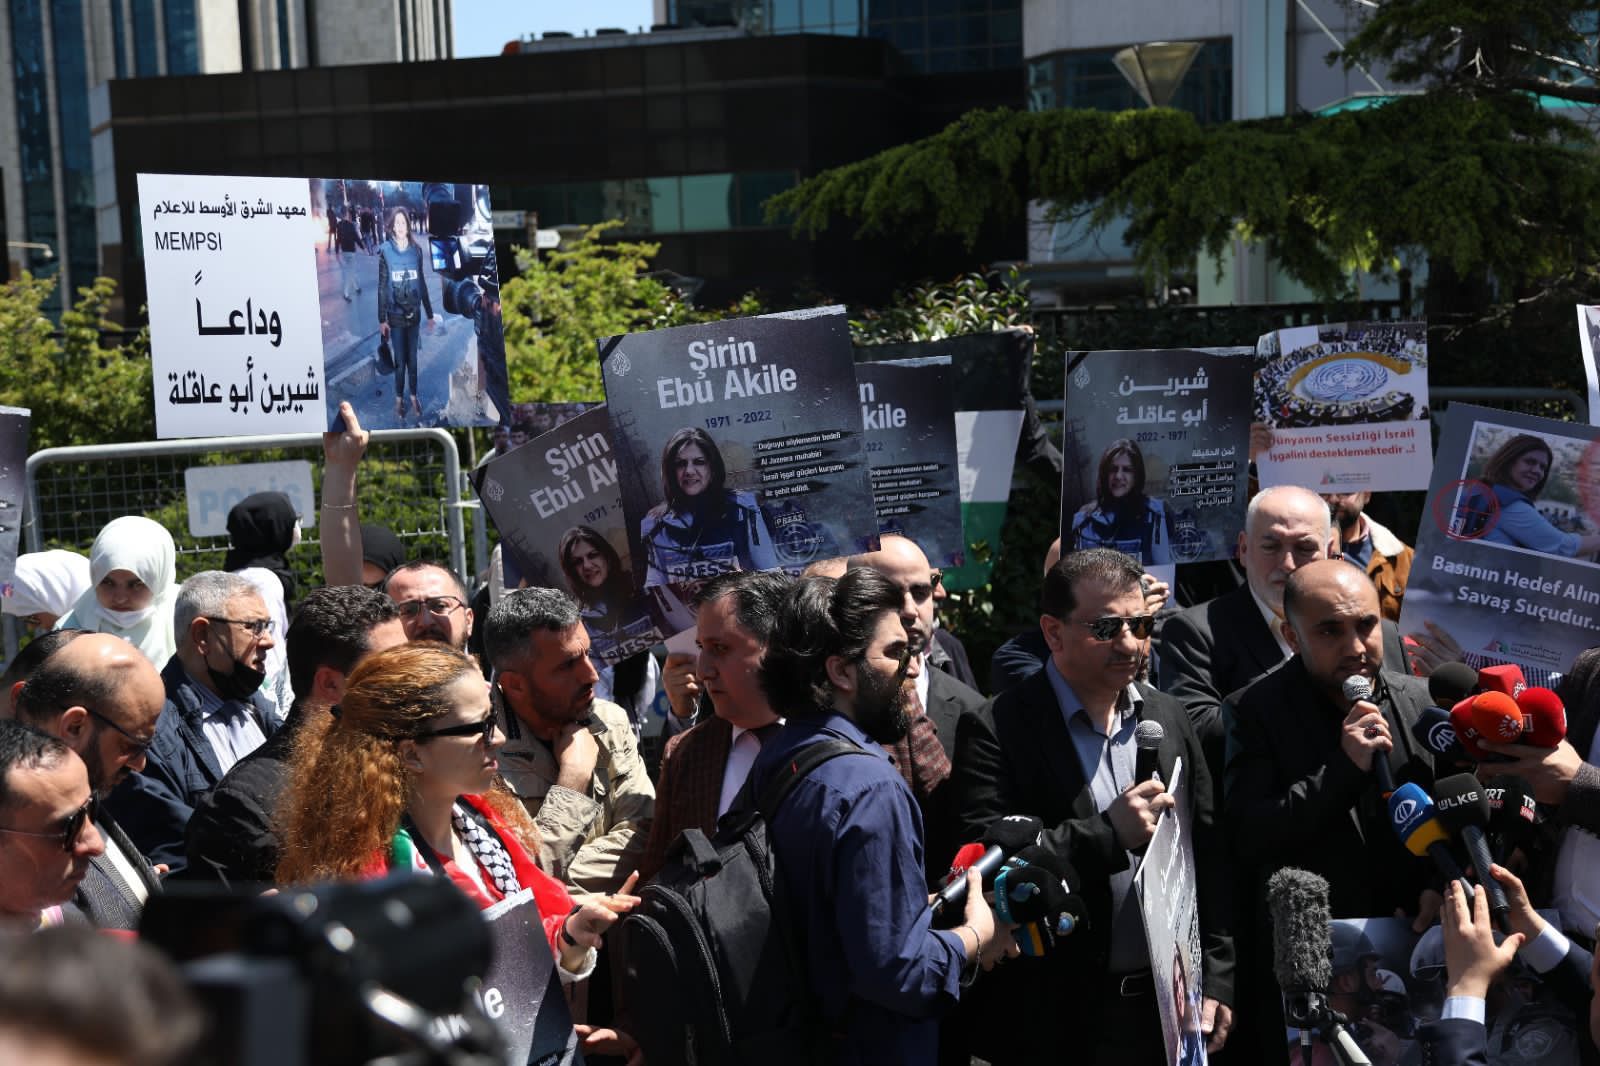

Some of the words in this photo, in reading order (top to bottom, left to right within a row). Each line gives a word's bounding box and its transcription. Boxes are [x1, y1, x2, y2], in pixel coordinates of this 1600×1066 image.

[199, 194, 237, 218] الأوسط
[240, 198, 273, 219] الشرق
[276, 207, 307, 220] معهد
[155, 231, 222, 251] MEMPSI
[688, 337, 757, 380] Şirin
[168, 370, 222, 405] عاقلة
[229, 356, 254, 415] أبو
[261, 365, 319, 414] شيرين
[724, 364, 798, 401] Akile
[1119, 366, 1209, 397] شيرين
[705, 415, 731, 429] 1971
[862, 403, 907, 431] kile
[1116, 404, 1177, 425] عاقلة
[1182, 398, 1209, 427] أبو
[1136, 431, 1159, 441] 2022
[1168, 430, 1188, 441] 1971
[1326, 428, 1381, 443] Sessizliği
[545, 432, 610, 483] Şirin
[1309, 444, 1403, 458] desteklemektedir
[197, 473, 304, 525] POS
[1432, 555, 1500, 583] Basının
[1503, 569, 1563, 596] Hedef
[1456, 586, 1511, 614] Savaş
